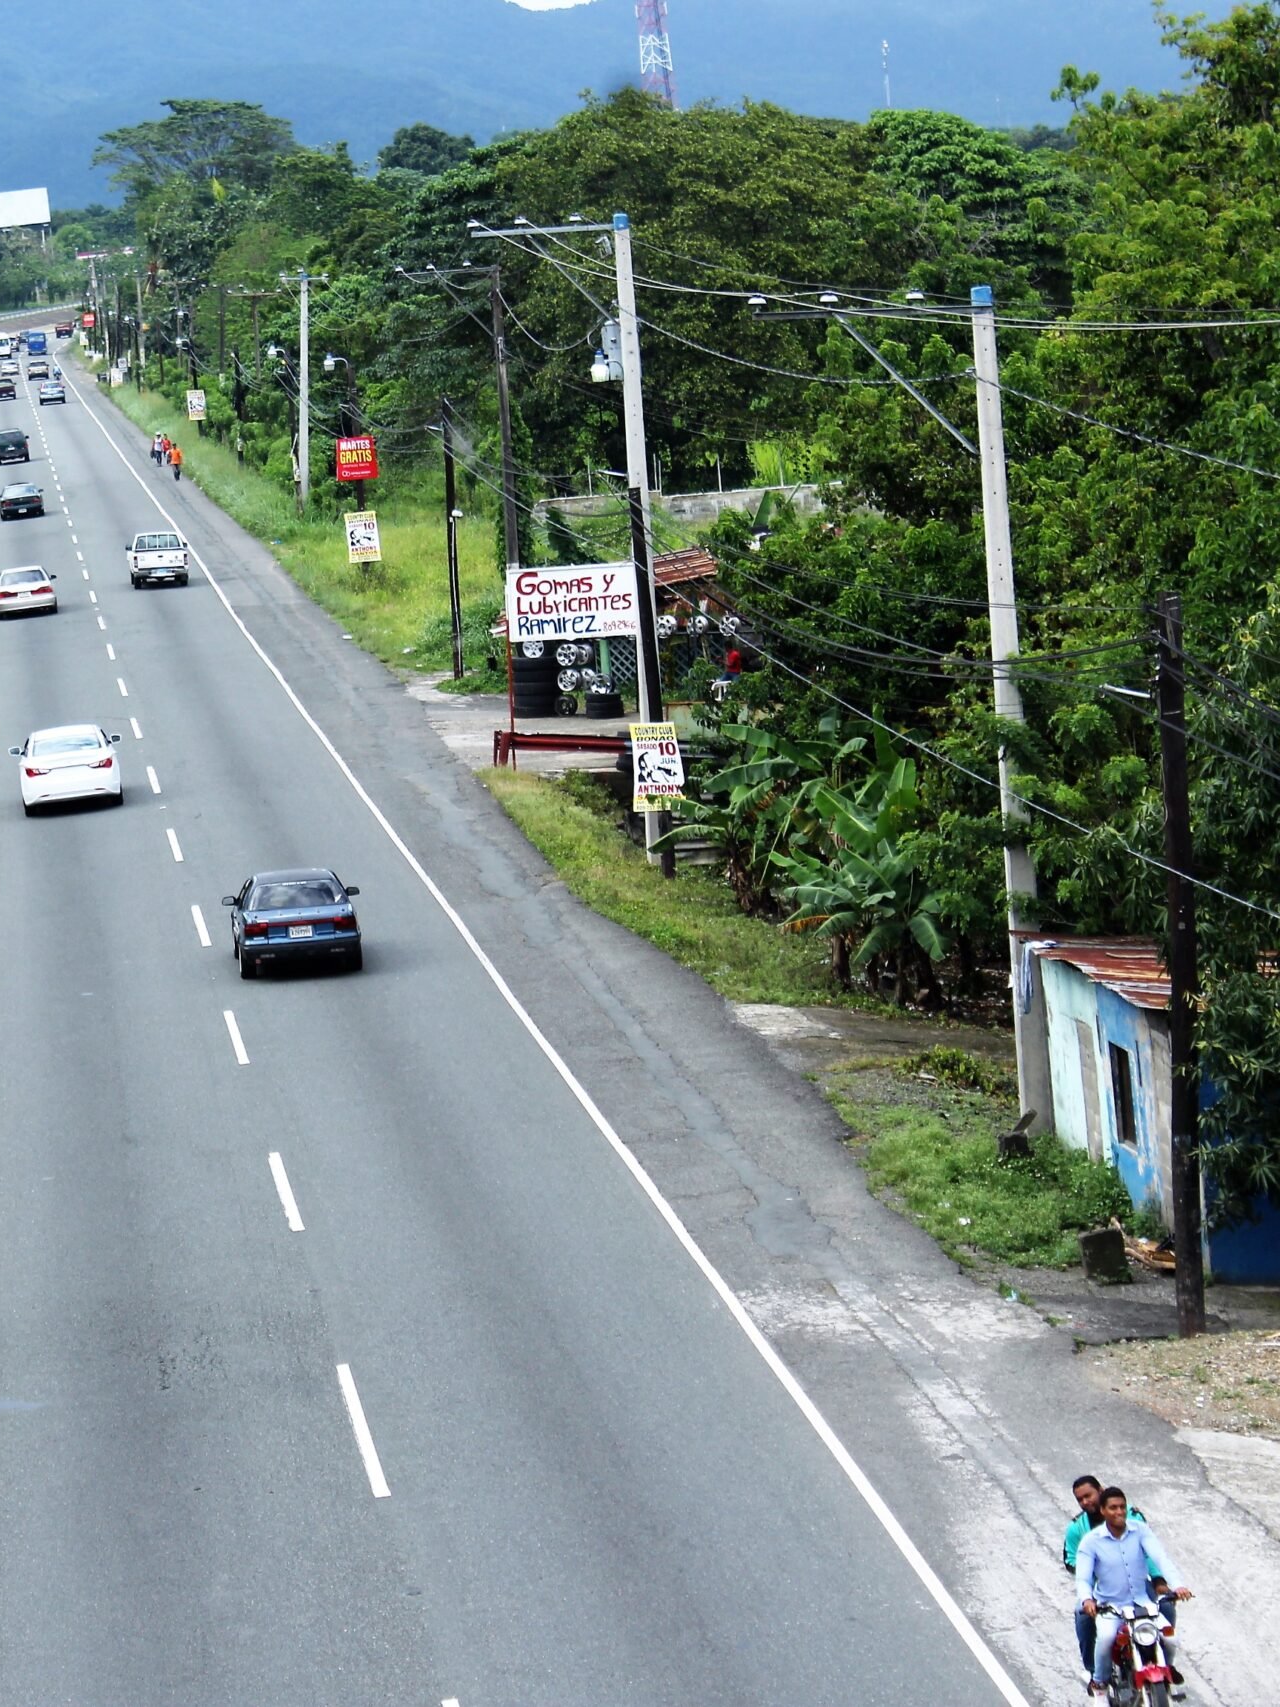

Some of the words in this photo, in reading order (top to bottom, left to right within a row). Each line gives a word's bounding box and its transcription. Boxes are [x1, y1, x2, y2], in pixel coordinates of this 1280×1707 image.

[340, 440, 370, 450] MARTES
[340, 450, 372, 464] GRATIS
[363, 522, 375, 530] 10
[635, 726, 657, 736] COUNTRY
[659, 726, 673, 735] CLUB
[658, 742, 677, 756] 10
[638, 785, 680, 794] ANTHONY
